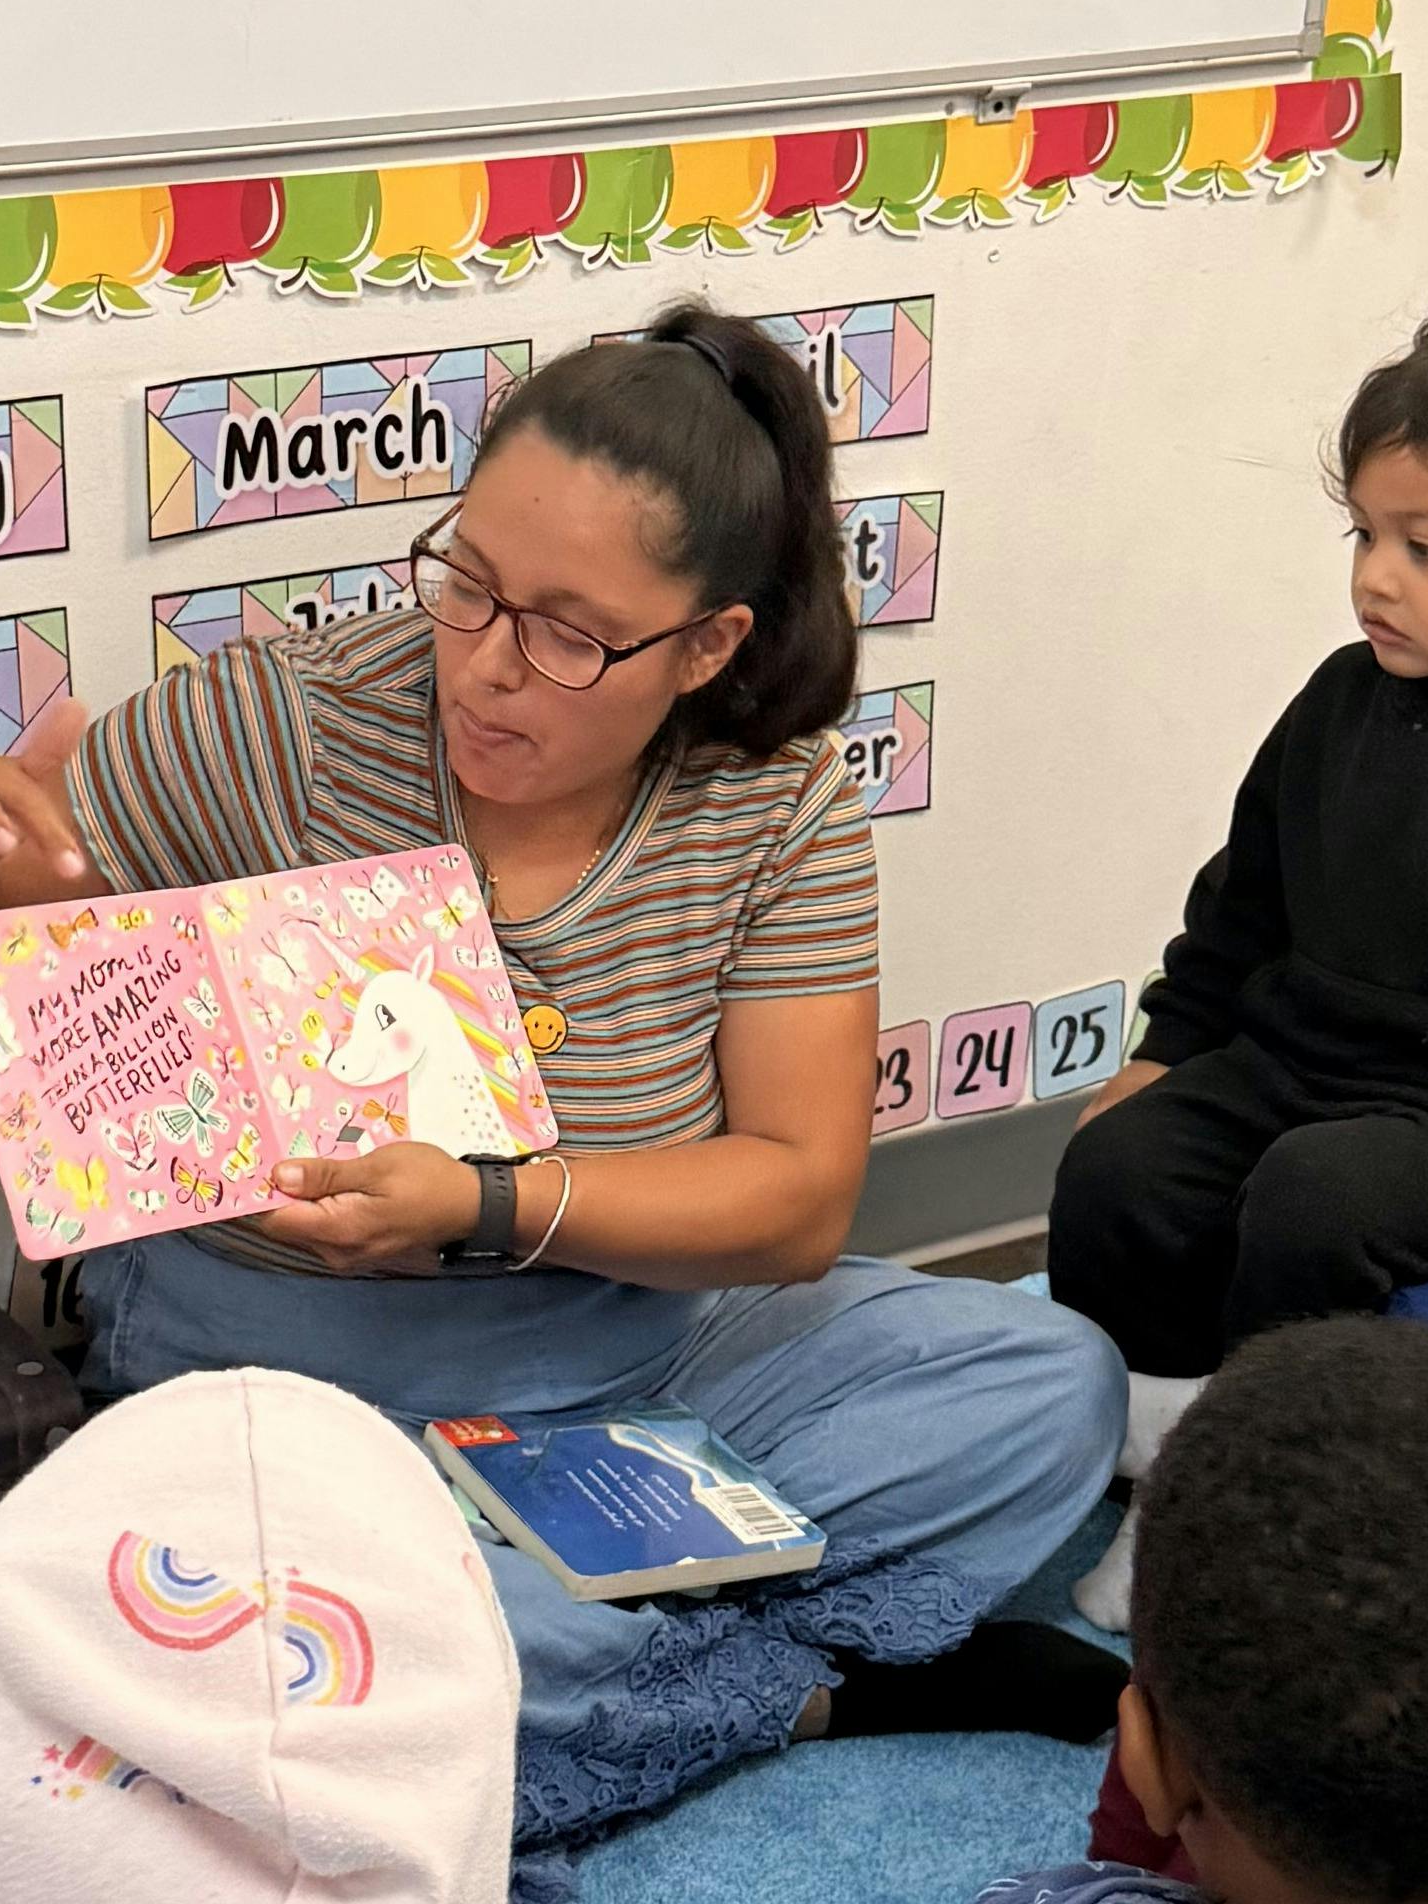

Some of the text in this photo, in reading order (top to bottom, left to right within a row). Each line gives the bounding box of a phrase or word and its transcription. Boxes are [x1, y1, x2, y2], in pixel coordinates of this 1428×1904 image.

[223, 373, 448, 492] March
[29, 993, 69, 1034] MY
[138, 945, 153, 965] IS
[30, 950, 182, 1080] MORE AMAZING
[64, 1023, 194, 1134] BUTTERFLIES!
[106, 1006, 179, 1075] BILLION
[953, 1026, 1017, 1096] 24
[1051, 1005, 1109, 1078] 25
